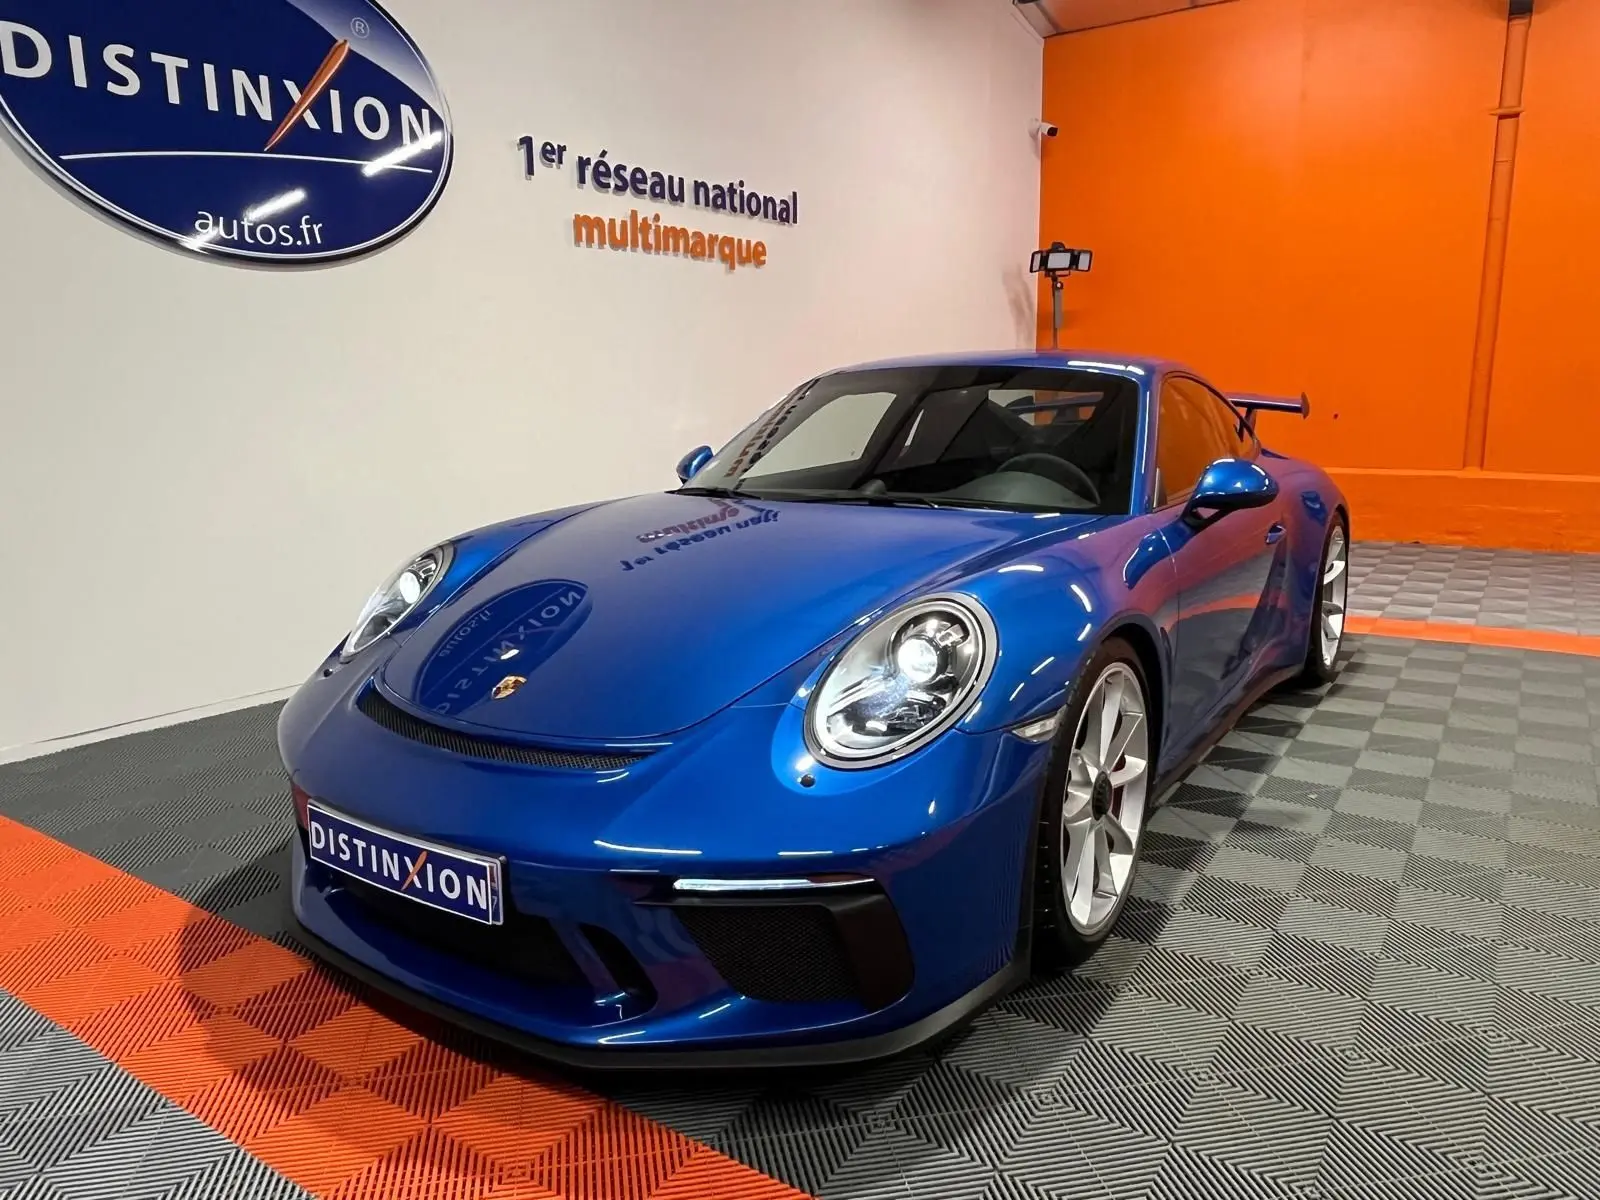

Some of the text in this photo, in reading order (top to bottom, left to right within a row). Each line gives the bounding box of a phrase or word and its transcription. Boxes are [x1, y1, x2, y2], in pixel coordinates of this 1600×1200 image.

[0, 20, 431, 151] DISTINXION
[517, 135, 798, 225] 1er réseau national
[194, 210, 323, 246] autos.fr
[573, 209, 767, 271] multimarque
[310, 821, 487, 910] DISTINXION
